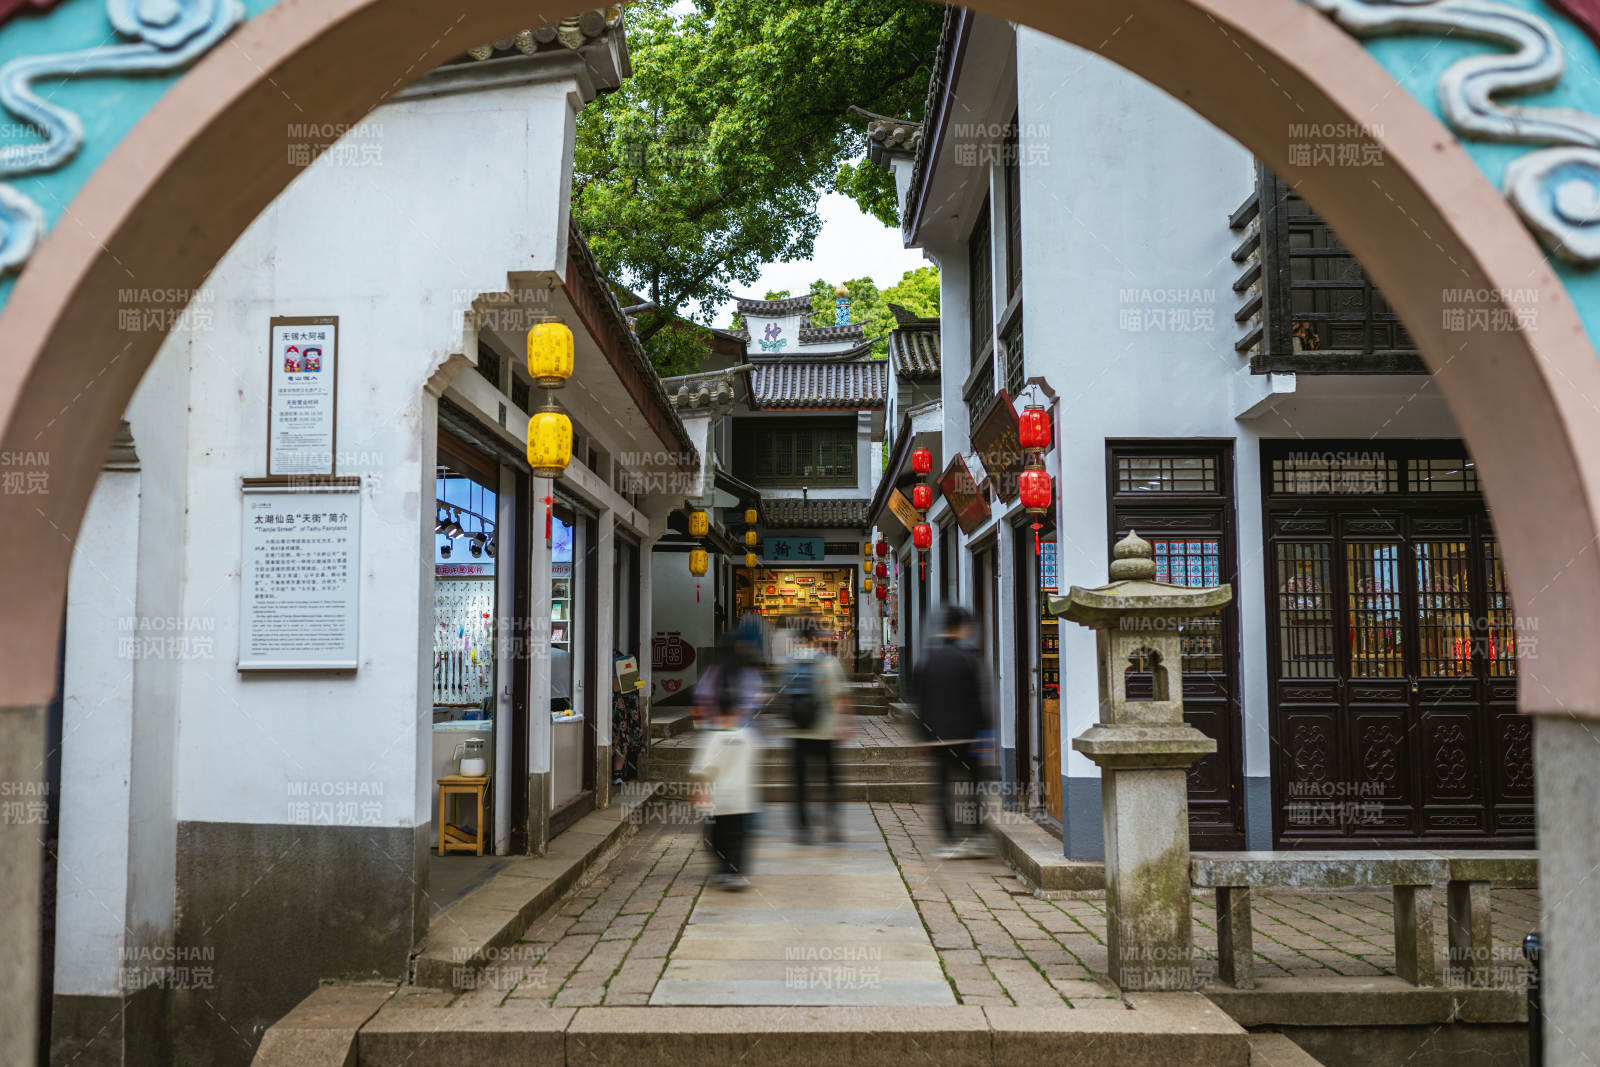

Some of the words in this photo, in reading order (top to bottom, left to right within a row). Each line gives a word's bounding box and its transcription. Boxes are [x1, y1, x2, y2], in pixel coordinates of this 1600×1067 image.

[282, 331, 326, 341] 无锡大阿福
[764, 322, 782, 348] 神
[254, 512, 348, 524] 太湖仙岛“天街”简介
